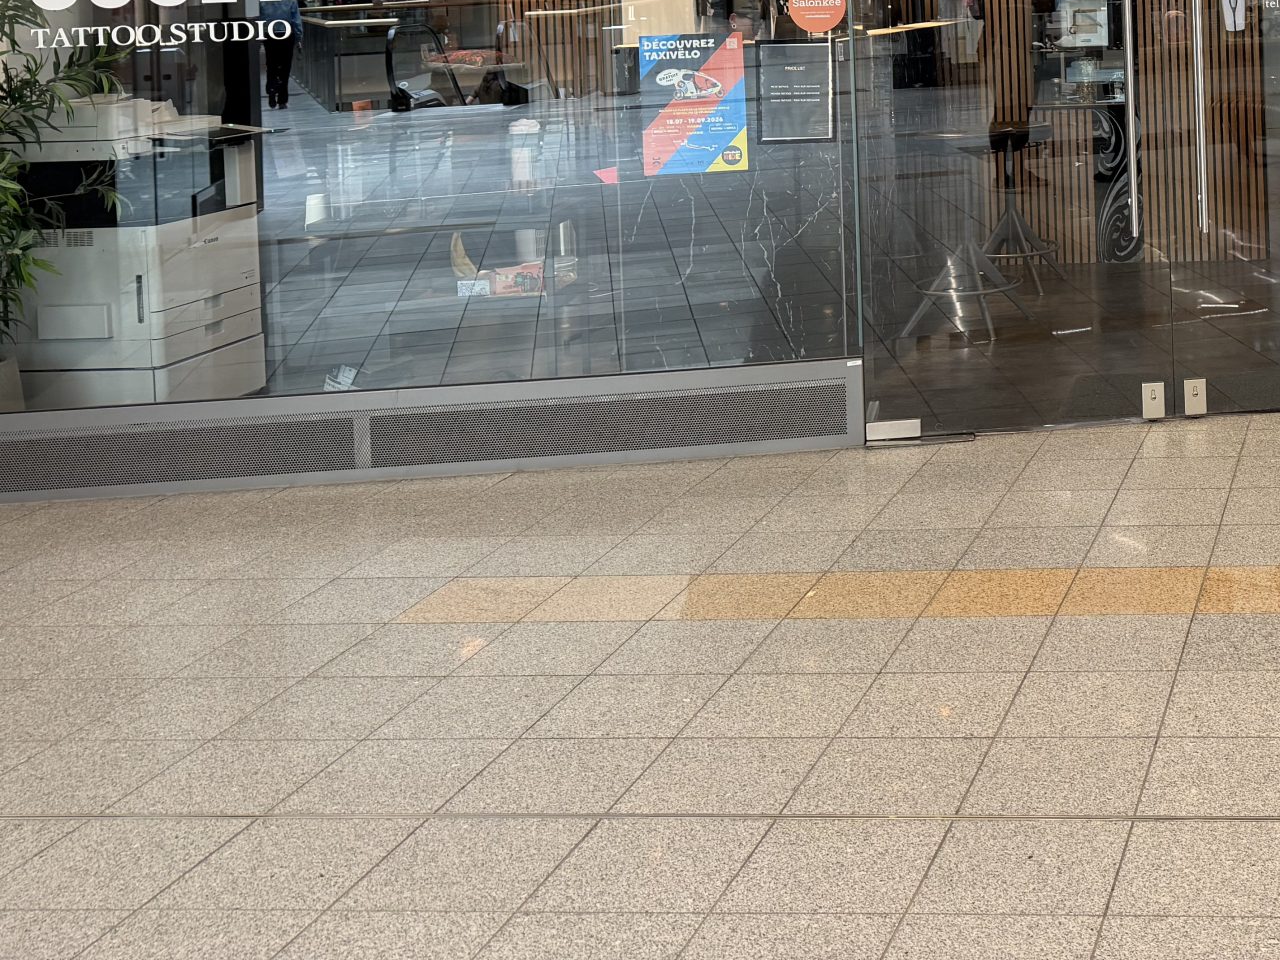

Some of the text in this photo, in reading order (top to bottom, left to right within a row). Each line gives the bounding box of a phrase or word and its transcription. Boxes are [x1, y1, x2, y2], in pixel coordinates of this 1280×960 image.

[30, 19, 292, 49] TATTOO STUDIO
[643, 38, 715, 50] DÉCOUVREZ
